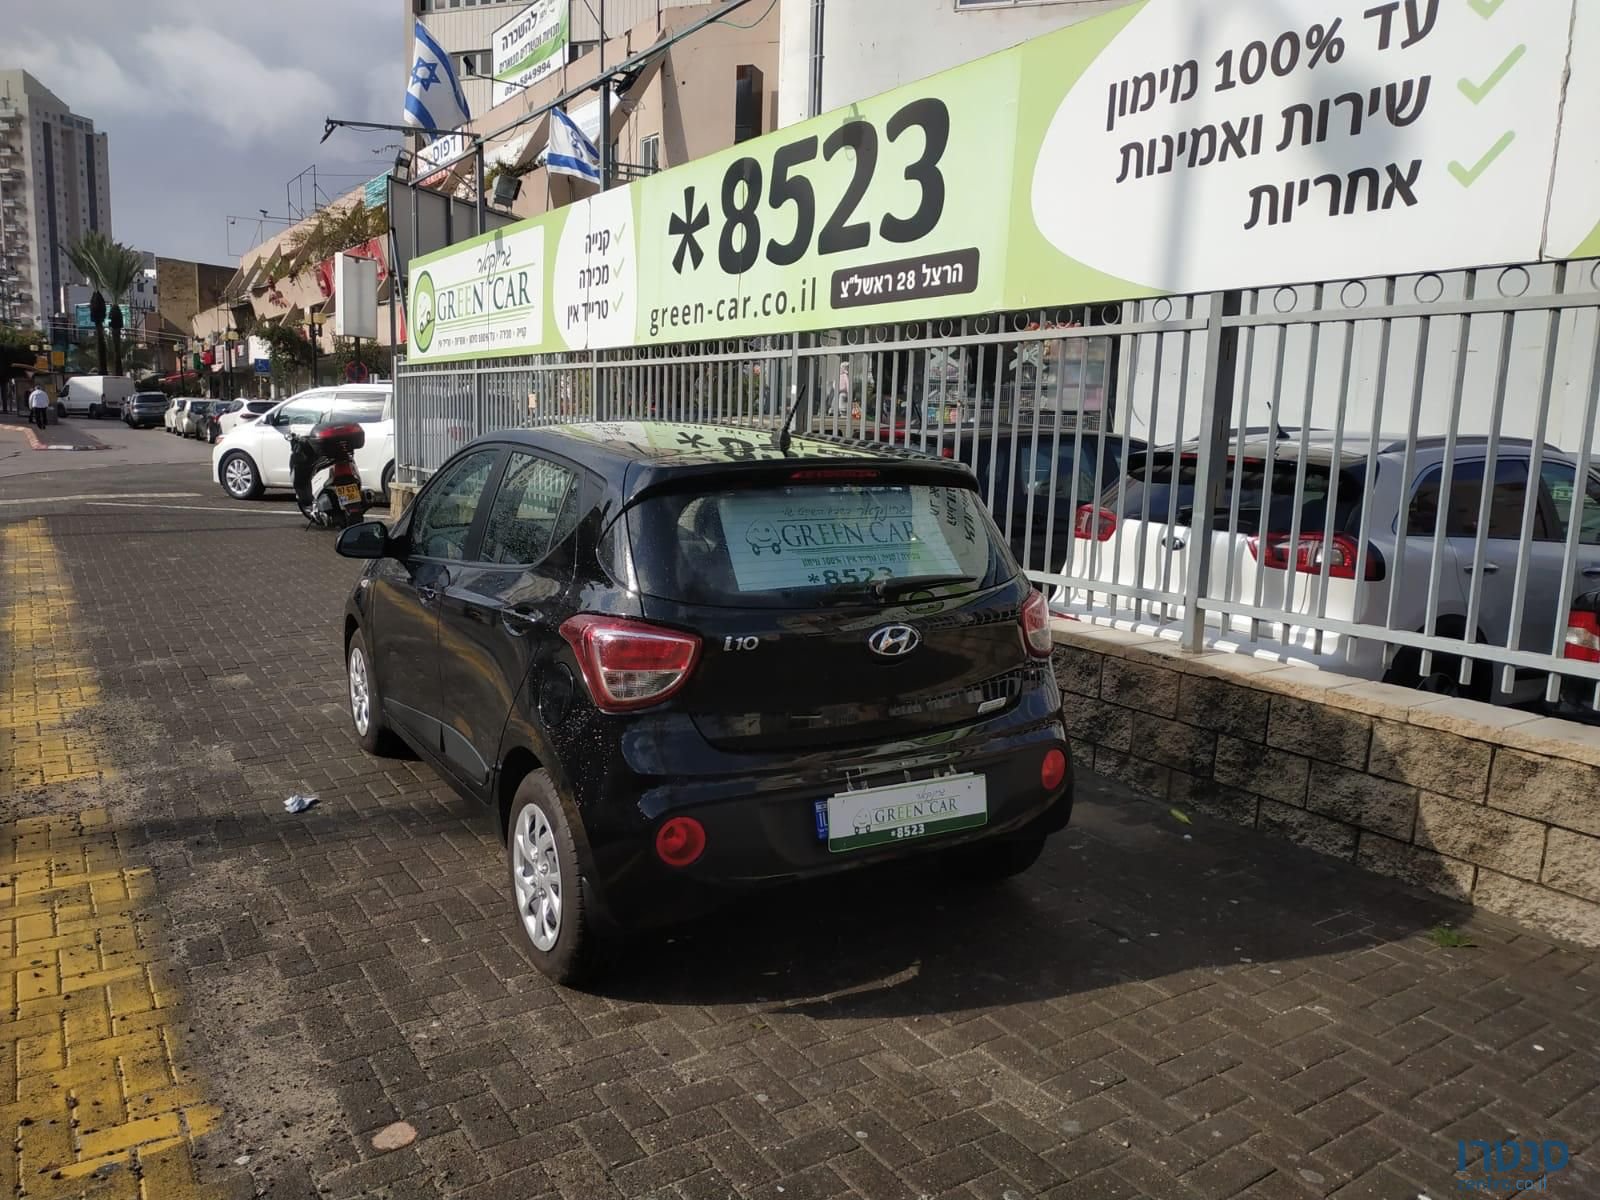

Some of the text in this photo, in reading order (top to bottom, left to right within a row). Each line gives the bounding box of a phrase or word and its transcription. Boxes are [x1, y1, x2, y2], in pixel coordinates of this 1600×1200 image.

[501, 10, 538, 51] להשכרה
[1106, 0, 1439, 131] עד 100% מימון
[1116, 76, 1432, 184] שירות ואמינות
[432, 135, 457, 162] דפוס
[1244, 159, 1422, 230] אחריות
[585, 229, 610, 256] קנייה
[579, 264, 610, 289] מכירה
[897, 270, 917, 290] 28
[922, 262, 963, 288] הרצל
[437, 271, 531, 321] GREEN CAR
[649, 277, 817, 336] green-car.co.il
[567, 299, 609, 330] טרייד אין
[781, 520, 921, 548] GREEN CAR
[723, 635, 759, 652] i10
[874, 798, 959, 823] GREEN CAR
